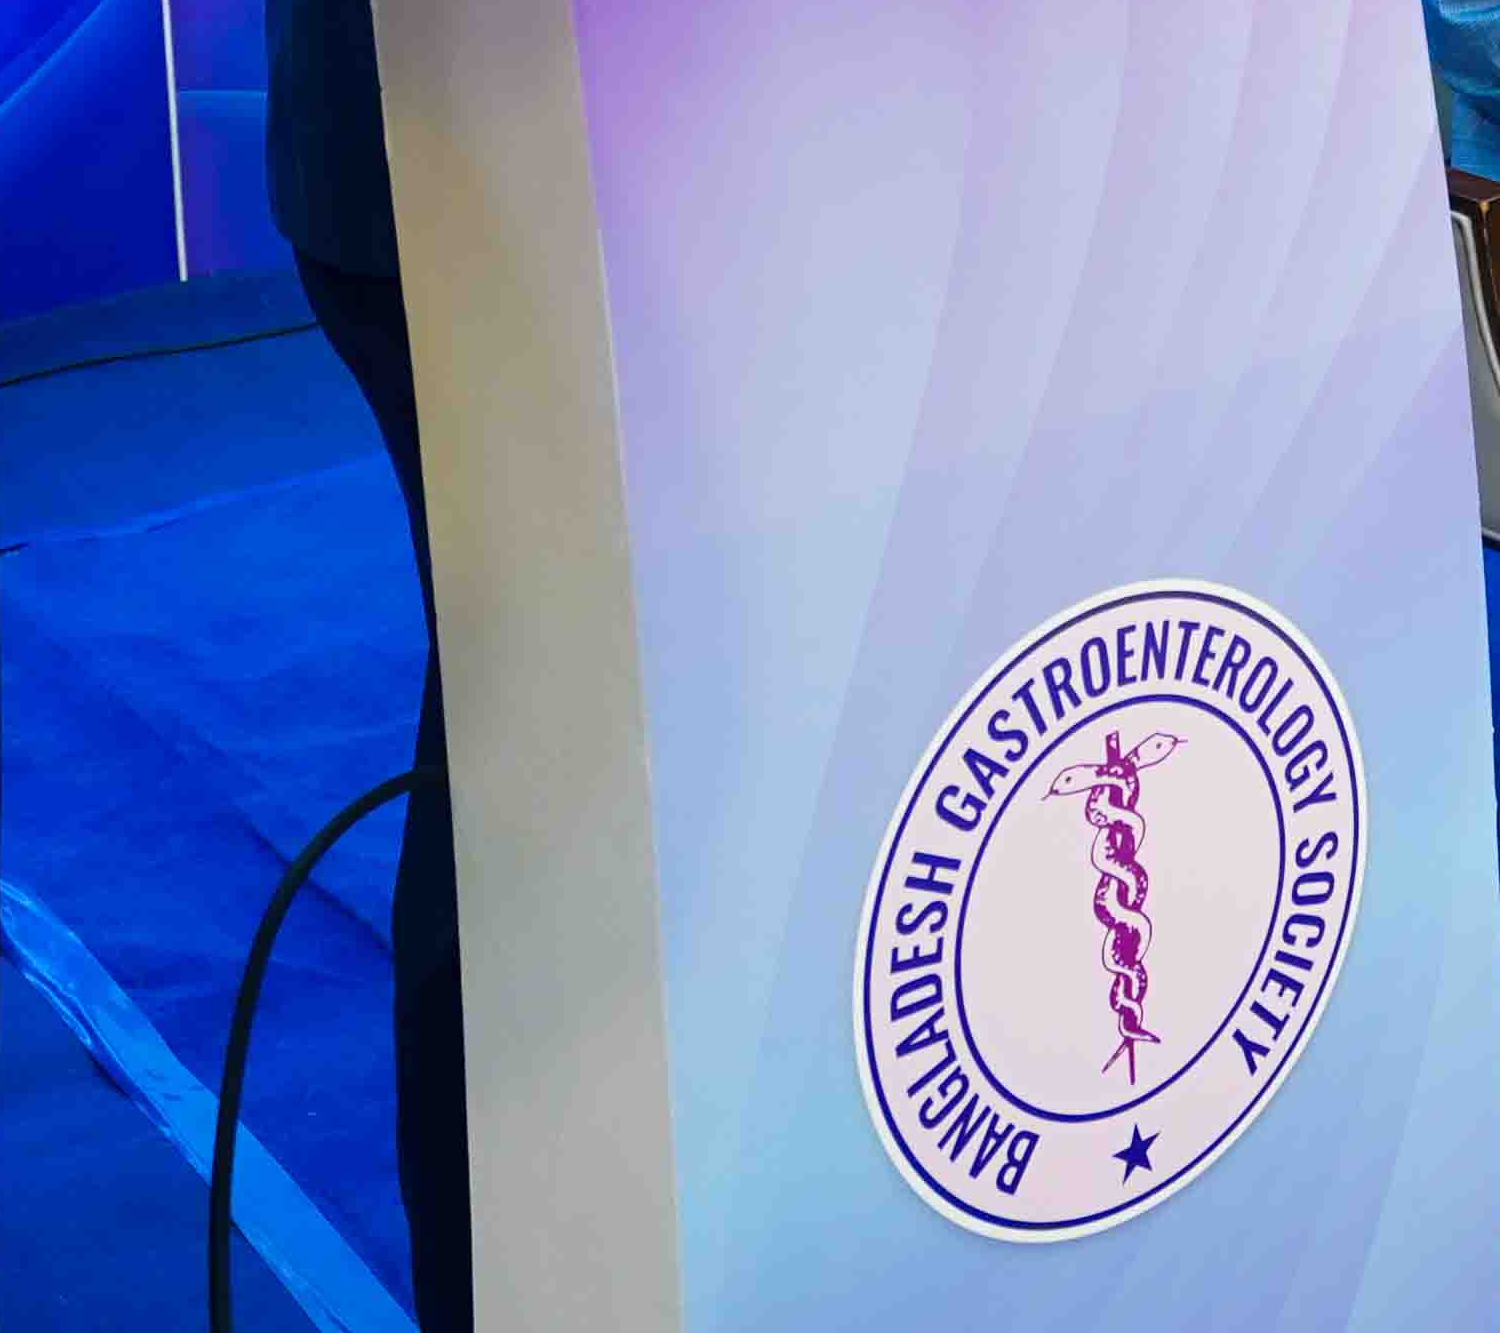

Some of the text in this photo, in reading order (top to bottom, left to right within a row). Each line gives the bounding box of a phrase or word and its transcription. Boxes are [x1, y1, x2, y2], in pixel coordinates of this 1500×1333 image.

[889, 620, 1340, 1196] BANGLADESH GASTROENTEROLOGY SOCIETY
